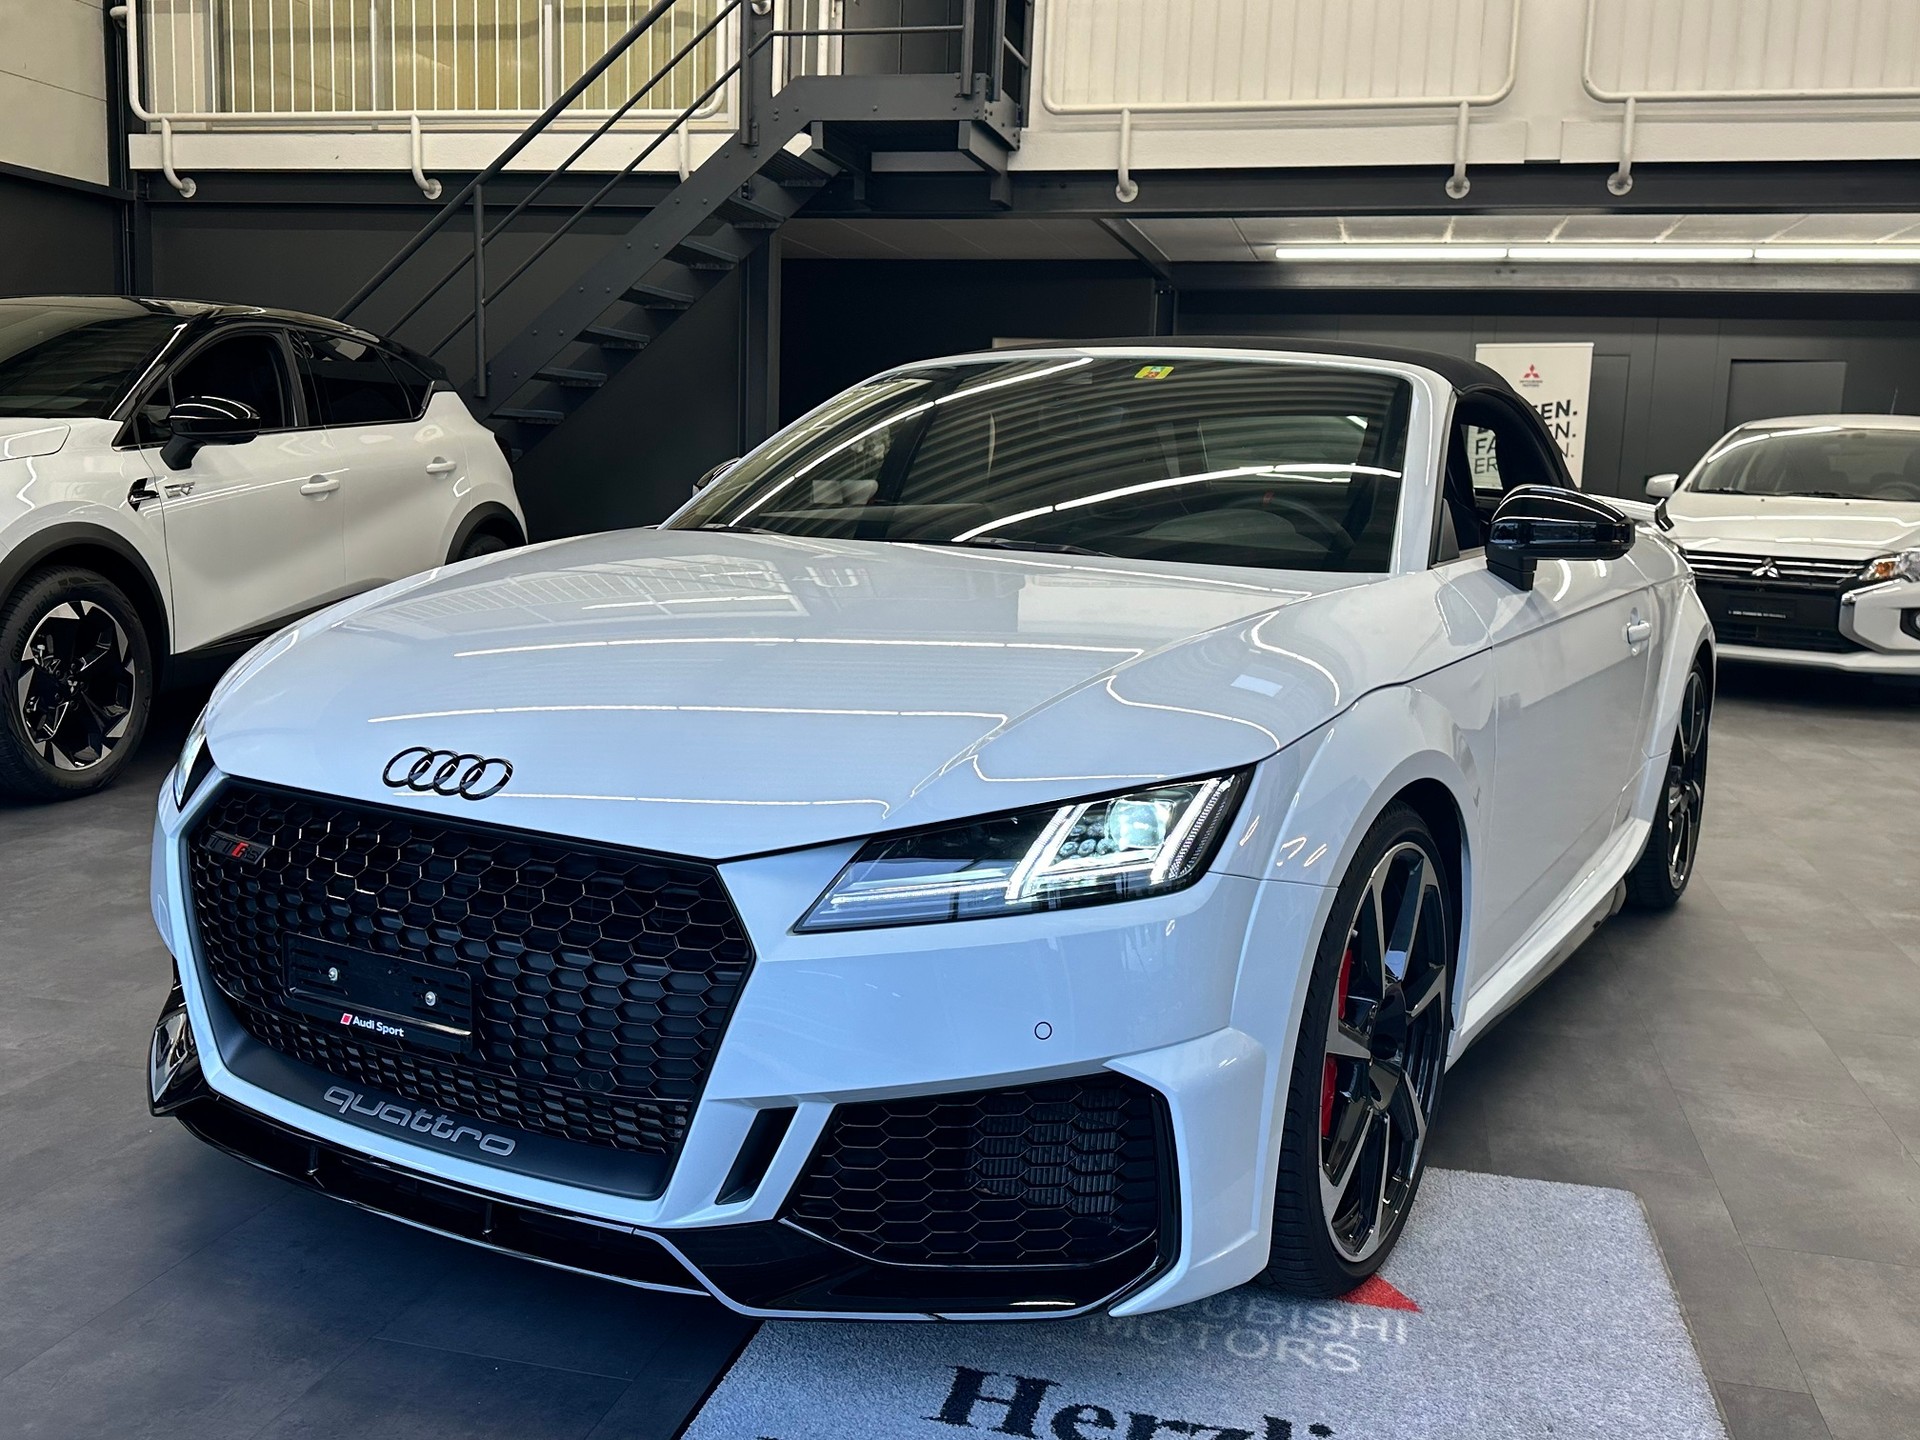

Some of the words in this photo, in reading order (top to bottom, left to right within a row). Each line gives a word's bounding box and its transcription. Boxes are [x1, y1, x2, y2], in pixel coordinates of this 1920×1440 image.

[352, 1016, 375, 1031] Audi
[376, 1021, 405, 1037] Sport
[323, 1085, 516, 1157] quattro
